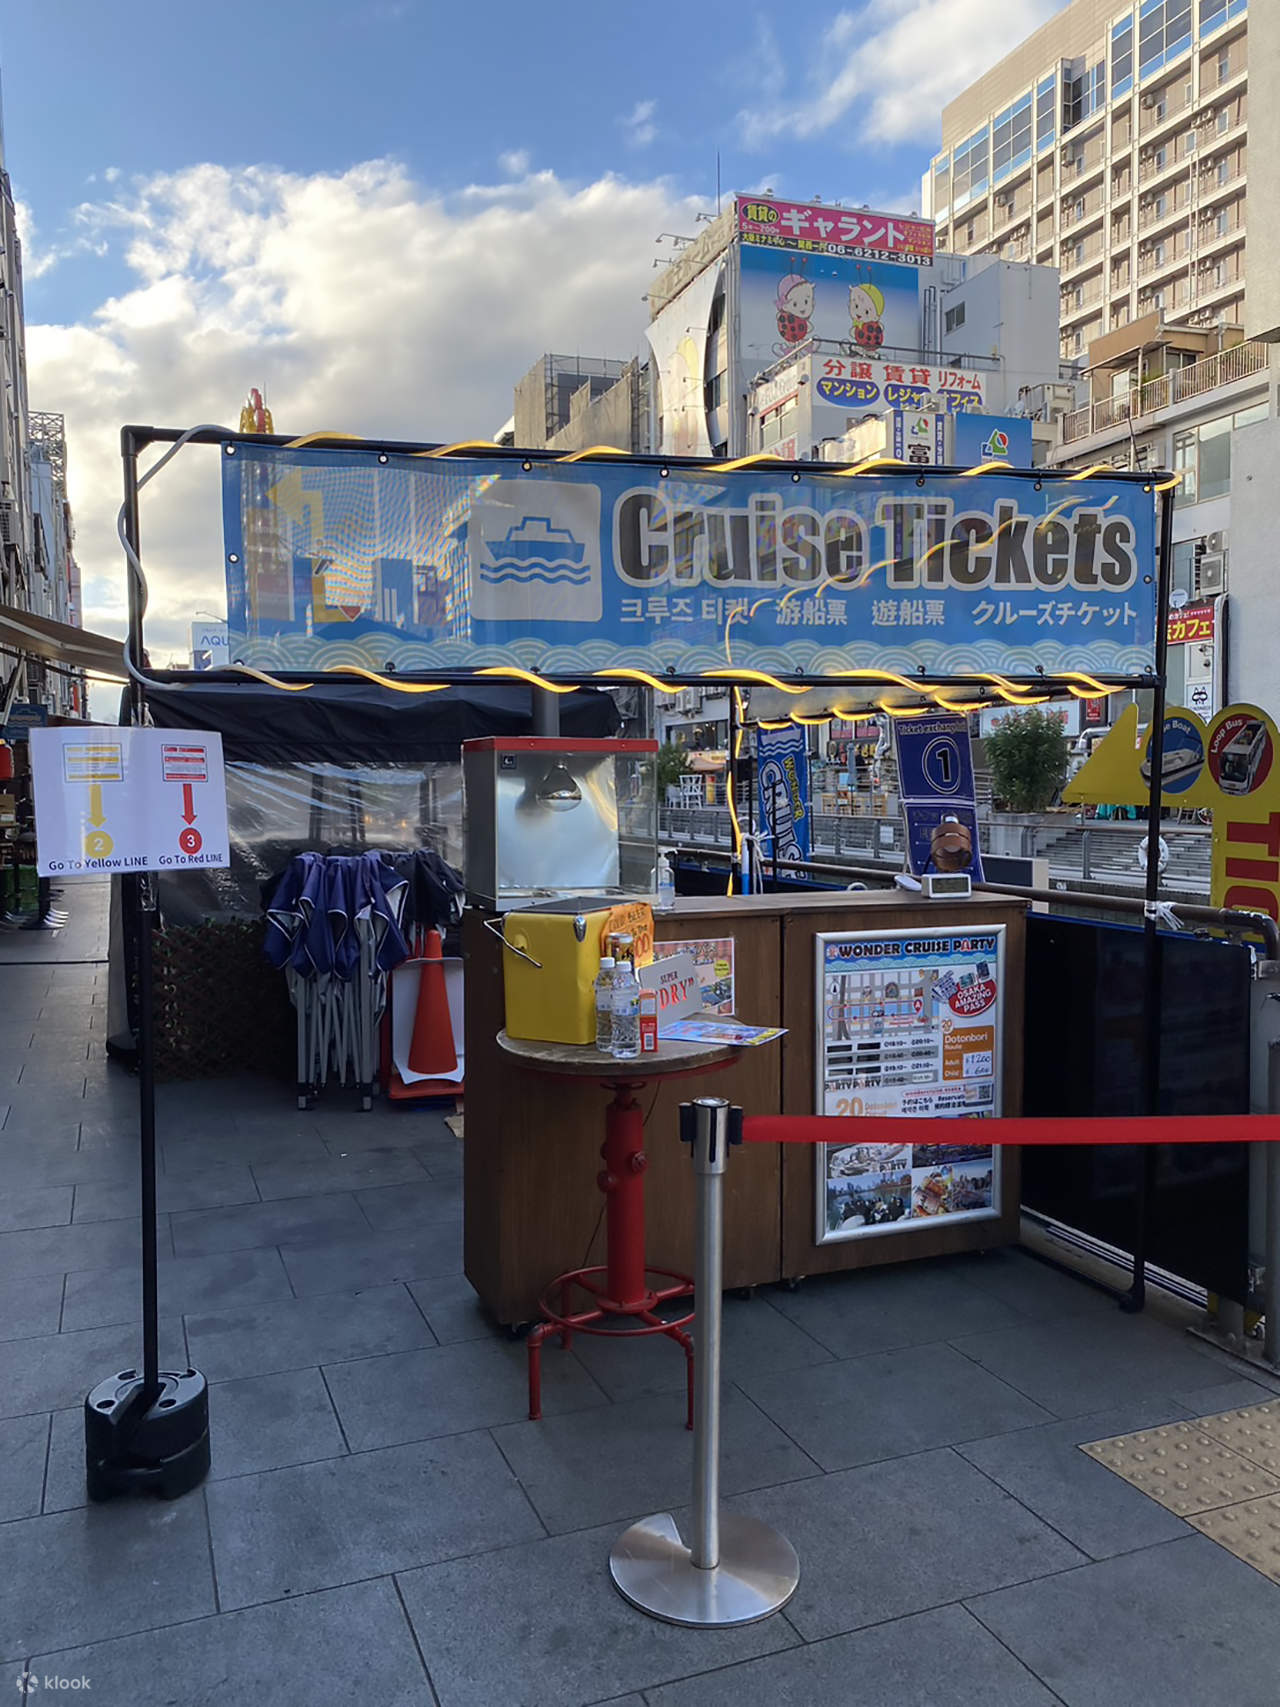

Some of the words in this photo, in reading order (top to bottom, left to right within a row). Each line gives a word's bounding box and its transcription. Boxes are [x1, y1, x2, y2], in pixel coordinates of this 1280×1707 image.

[781, 208, 905, 249] ギャラント
[828, 243, 931, 266] 06-6212-3013
[823, 358, 873, 380] 分譲
[883, 363, 931, 387] 賃貸
[938, 370, 982, 391] リフォーム
[821, 380, 878, 400] マンション
[943, 391, 980, 408] フィス
[613, 486, 867, 588] Cruise
[874, 498, 1138, 593] Tickets
[619, 598, 695, 626] 크루즈
[776, 598, 848, 627] 游船票
[872, 598, 946, 627] 遊船票
[972, 600, 1138, 626] クルーズチケット
[898, 722, 922, 734] Ticket
[1172, 720, 1191, 733] Boat
[1211, 729, 1226, 753] Loop
[1226, 720, 1243, 730] Bus
[936, 748, 950, 782] 1
[782, 754, 805, 822] WONDER
[94, 838, 104, 850] 2
[187, 835, 195, 848] 3
[49, 860, 64, 871] Go
[69, 859, 81, 869] To
[84, 857, 122, 869] Yellow
[124, 856, 148, 867] LINE
[159, 855, 173, 865] Go
[174, 855, 187, 864] To
[188, 854, 204, 864] Red
[206, 854, 223, 863] LINE
[839, 943, 904, 958] WONDER
[904, 940, 949, 955] CRUISE
[953, 938, 995, 952] PARTY
[660, 971, 678, 984] SUPER
[955, 989, 991, 1009] AMAZING
[957, 984, 986, 999] OSAKA
[963, 1000, 986, 1013] PASS
[945, 1032, 988, 1044] Dotonbori
